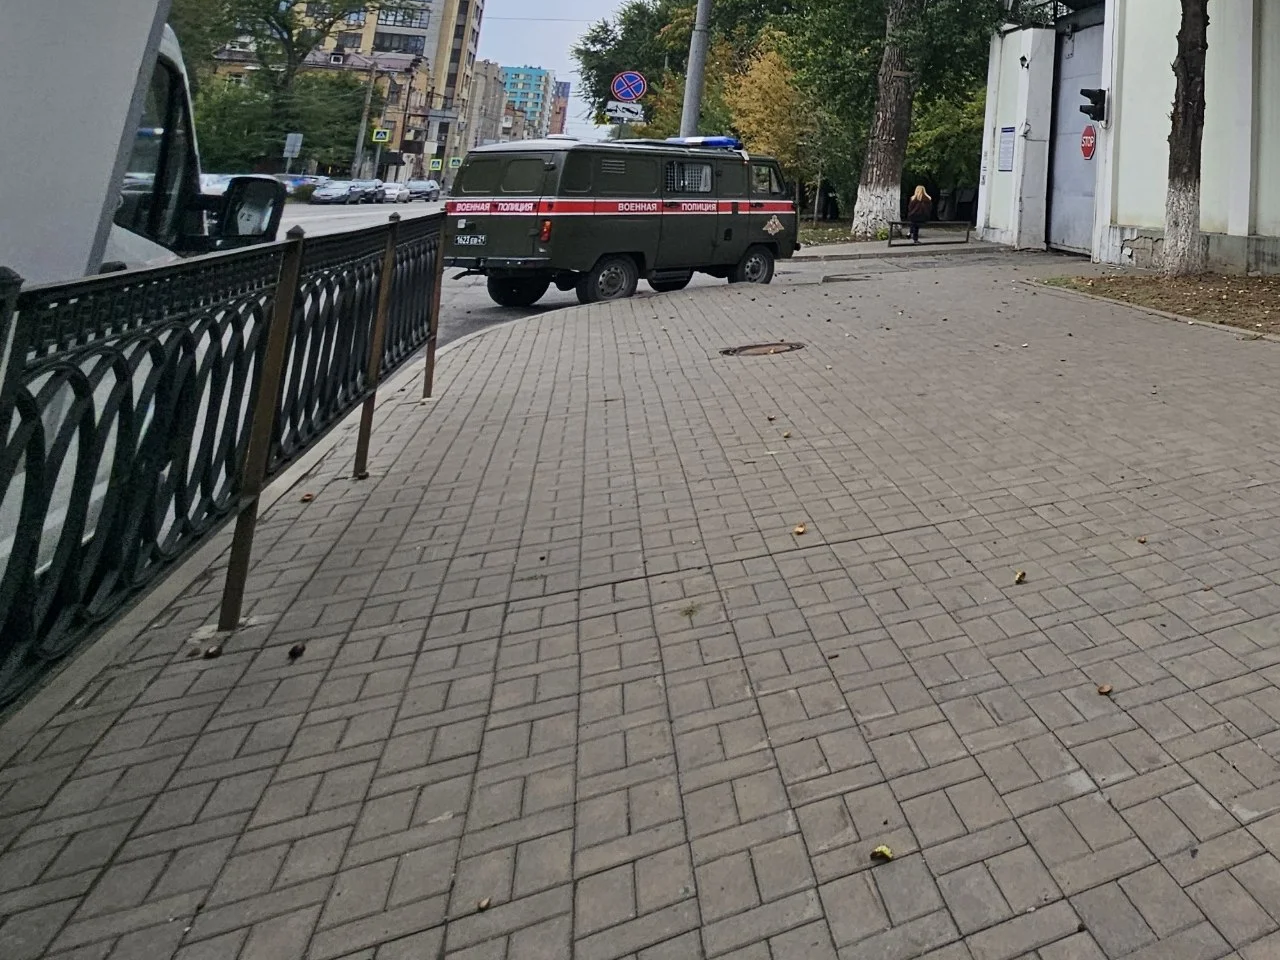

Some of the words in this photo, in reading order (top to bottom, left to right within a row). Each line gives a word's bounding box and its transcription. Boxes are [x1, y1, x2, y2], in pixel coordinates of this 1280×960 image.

[1081, 136, 1094, 147] STOP
[456, 202, 490, 212] ВОЕННАЯ
[497, 202, 533, 212] ПОЛИЦИЯ
[618, 202, 657, 212] ВОЕННАЯ
[682, 202, 717, 212] ПОЛИЦИЯ
